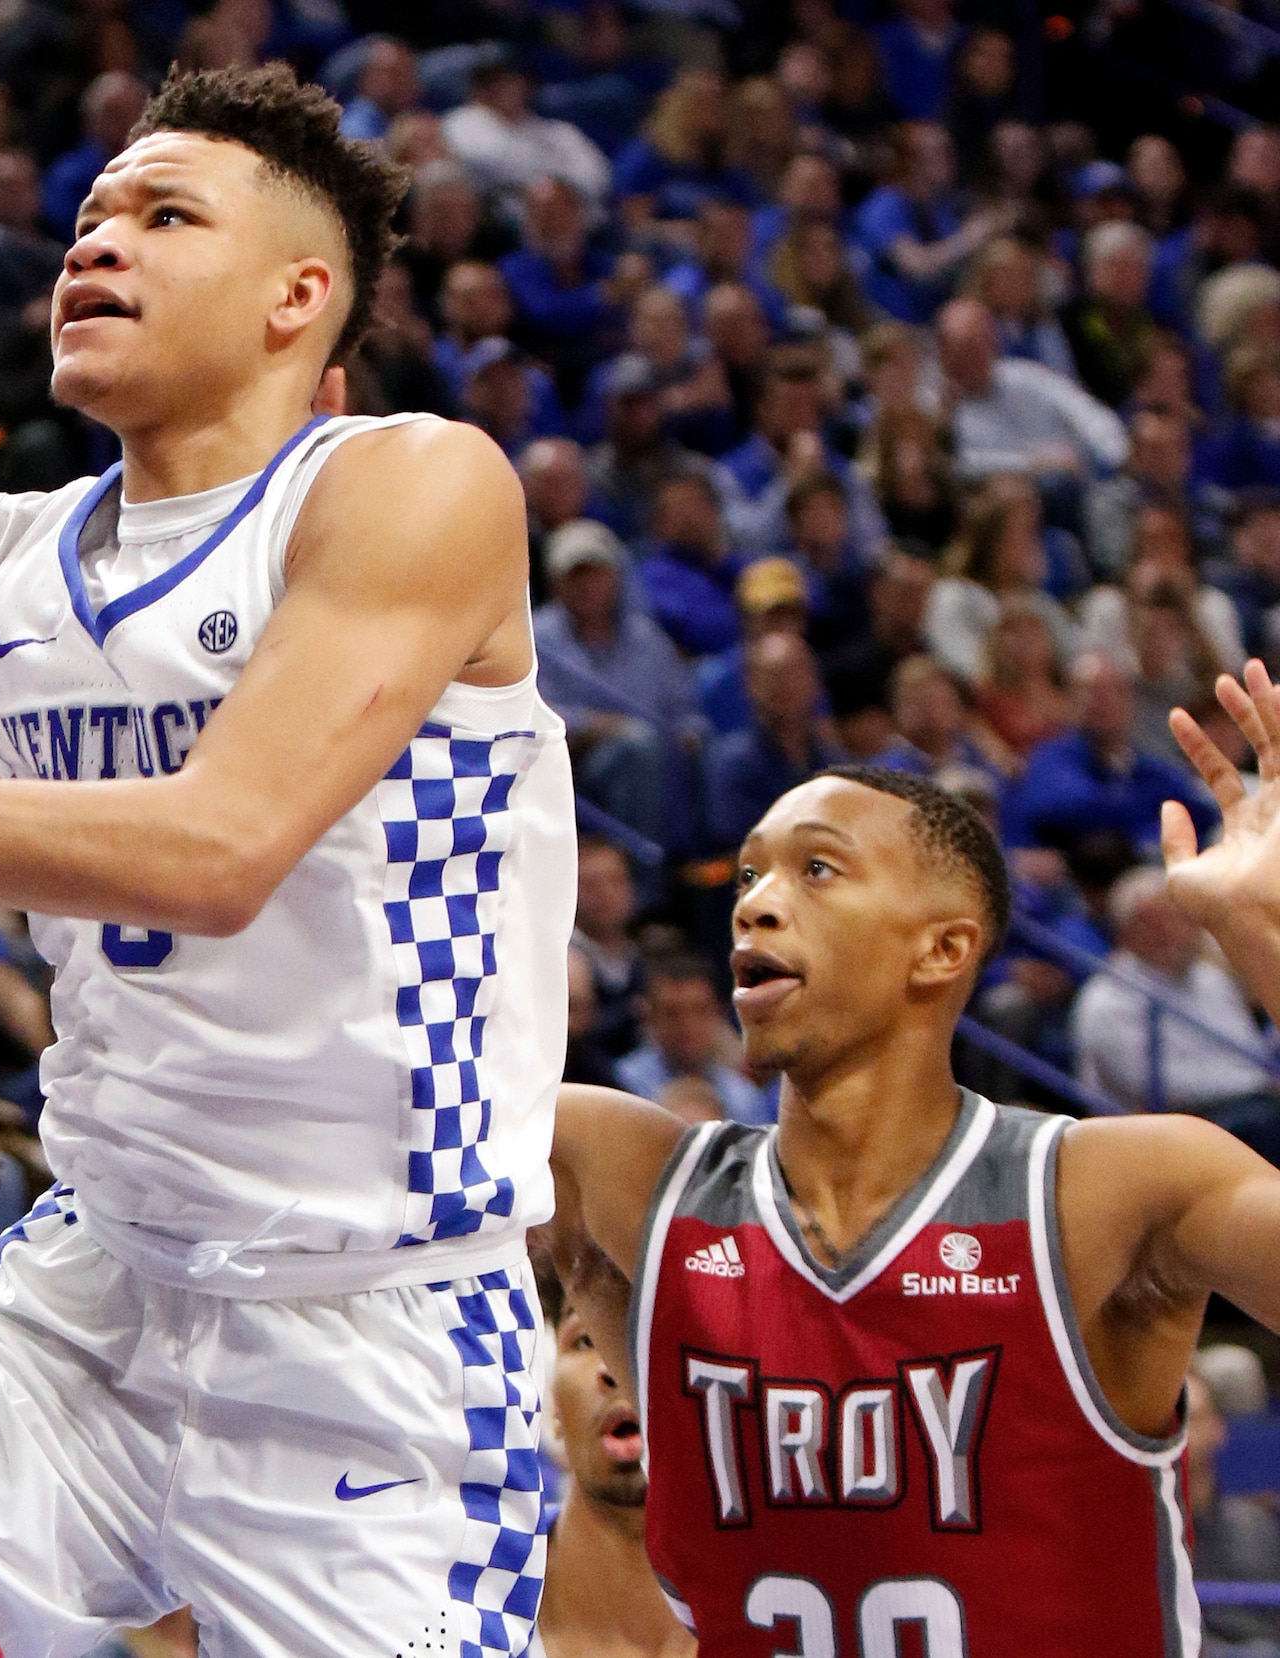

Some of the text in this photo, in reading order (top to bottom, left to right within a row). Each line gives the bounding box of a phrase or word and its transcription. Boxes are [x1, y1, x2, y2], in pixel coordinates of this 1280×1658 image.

[199, 610, 238, 653] SEC
[0, 697, 224, 780] ENTUC
[684, 1256, 746, 1278] adidas
[902, 1272, 1021, 1296] SUN BELT
[682, 1345, 1002, 1533] TROY
